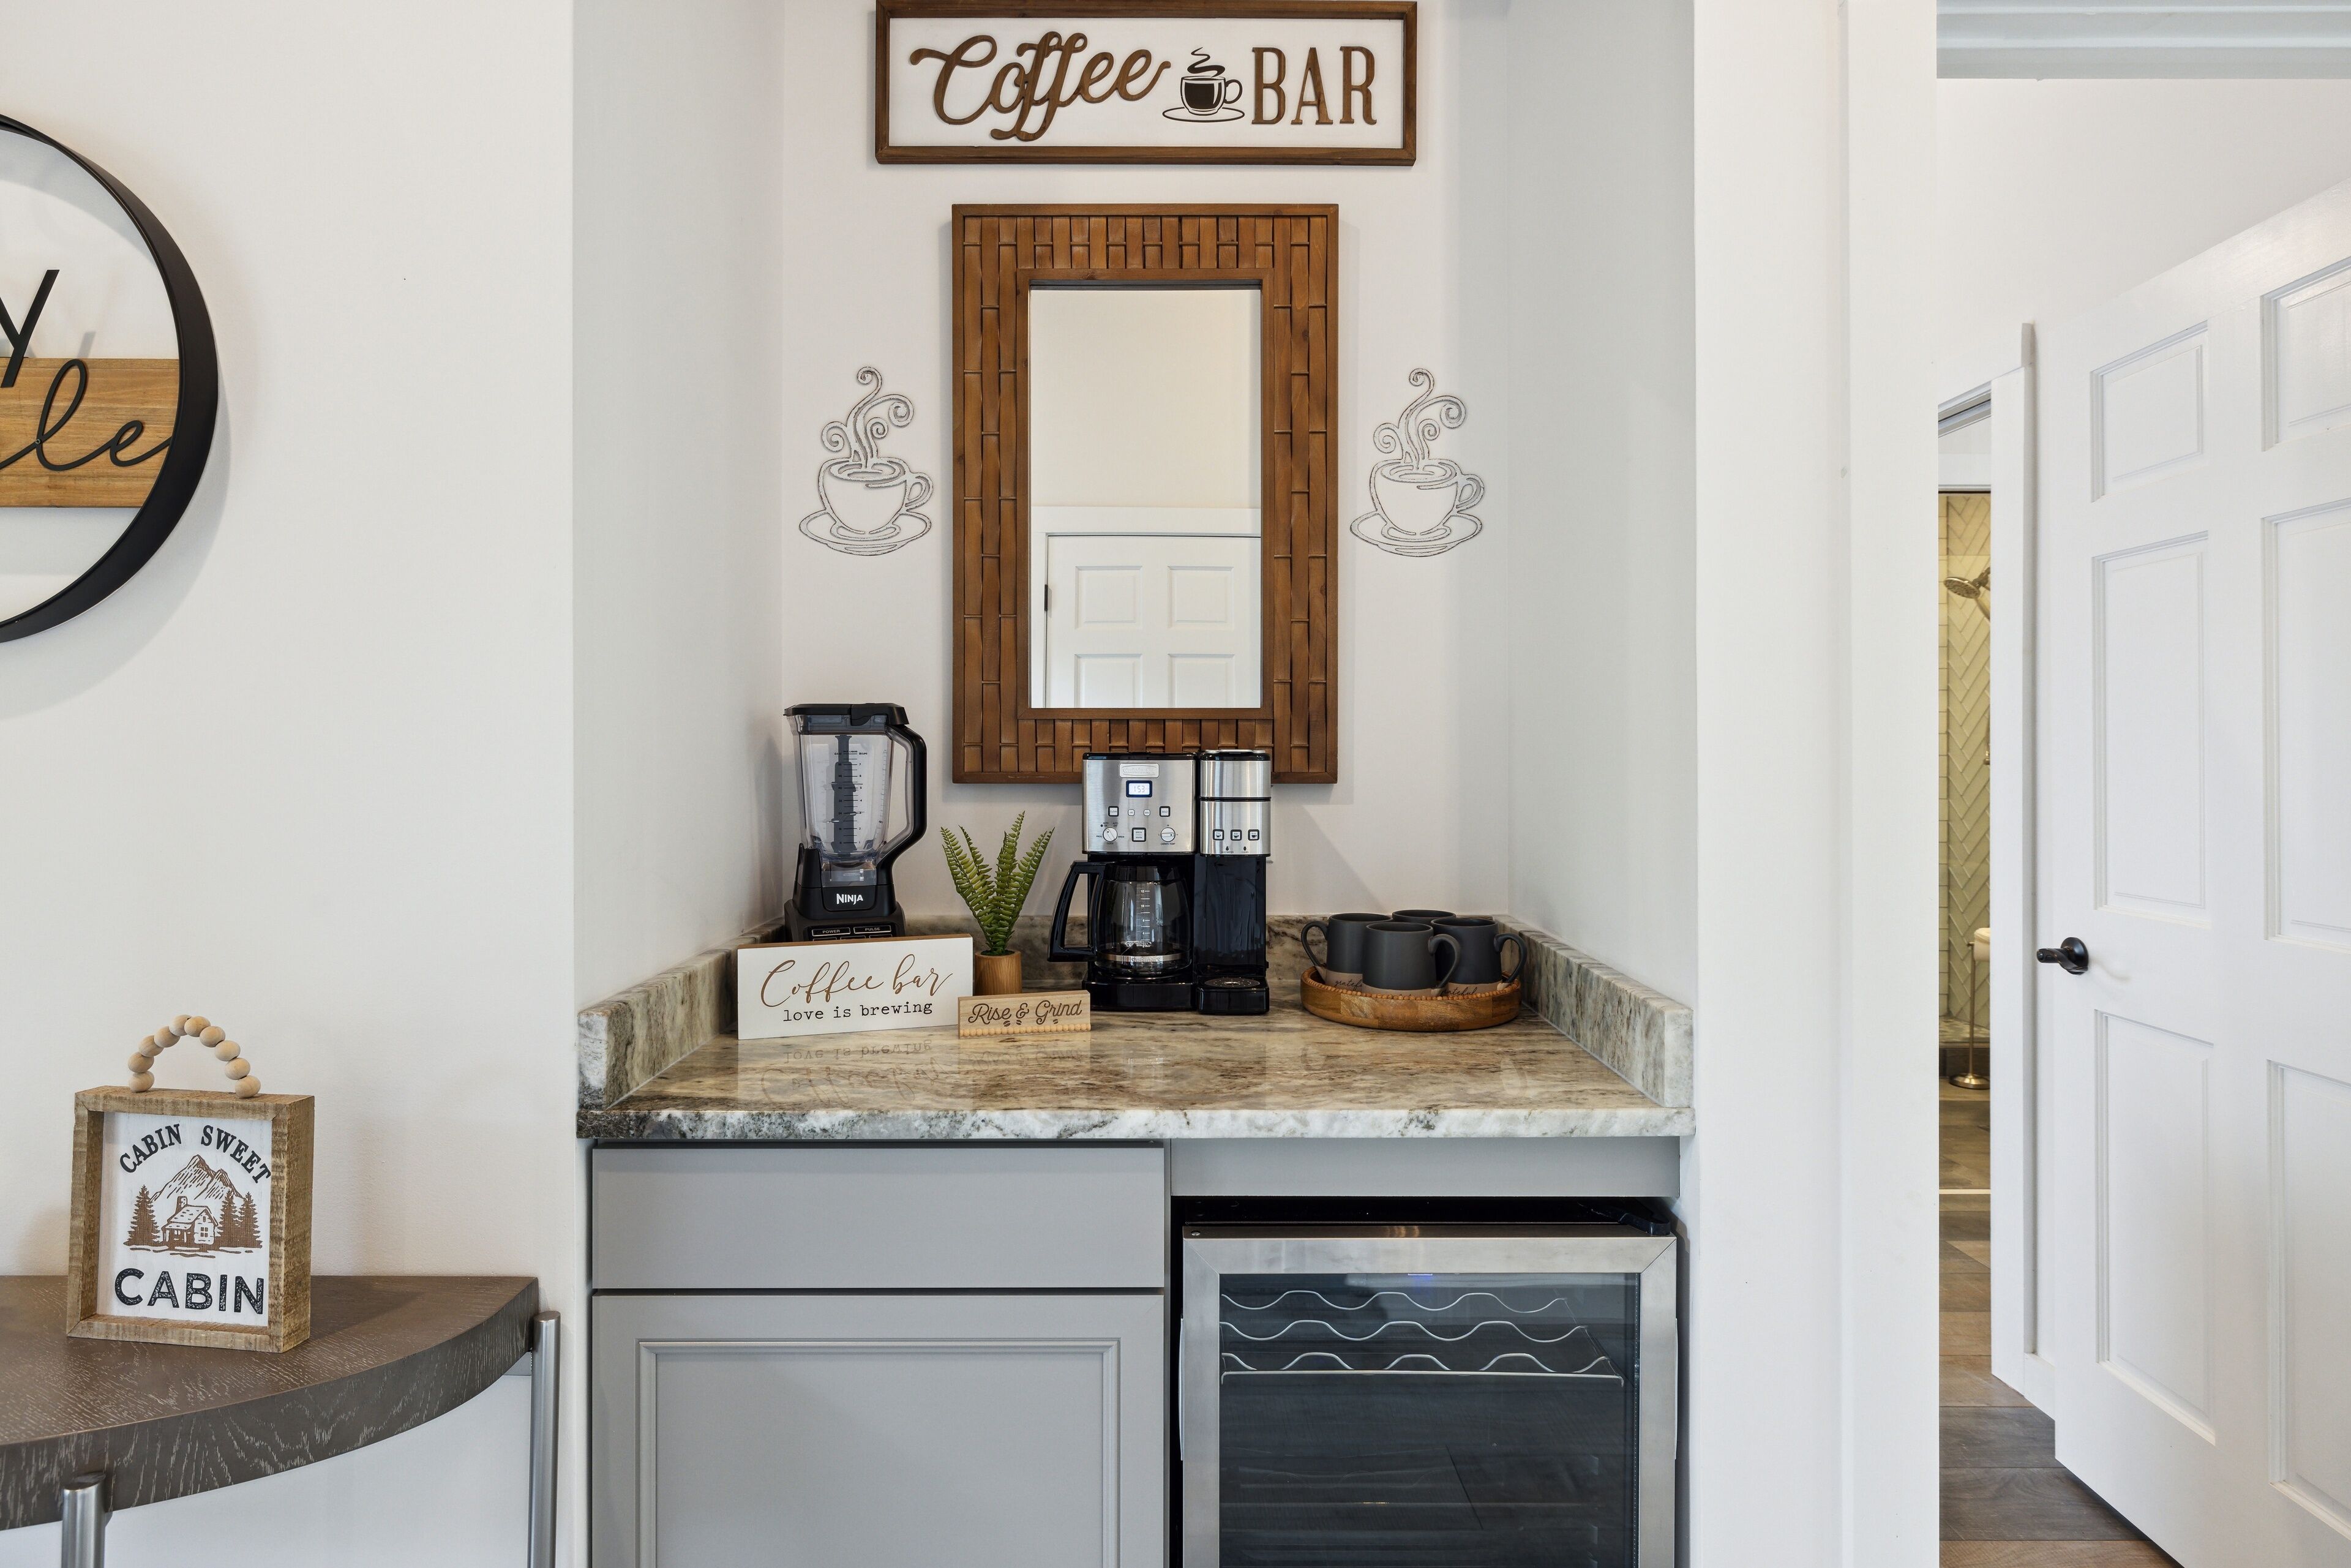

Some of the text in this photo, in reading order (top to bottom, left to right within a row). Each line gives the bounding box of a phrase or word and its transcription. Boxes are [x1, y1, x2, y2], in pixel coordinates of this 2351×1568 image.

[909, 31, 1378, 142] Coffee BAR
[836, 893, 864, 905] NINJA
[760, 953, 954, 1008] Coffee bar
[783, 1001, 933, 1022] love is brewing
[968, 1000, 1082, 1026] Rise & Grind
[119, 1123, 272, 1184] CABIN SWEET
[114, 1267, 264, 1315] CABIN
